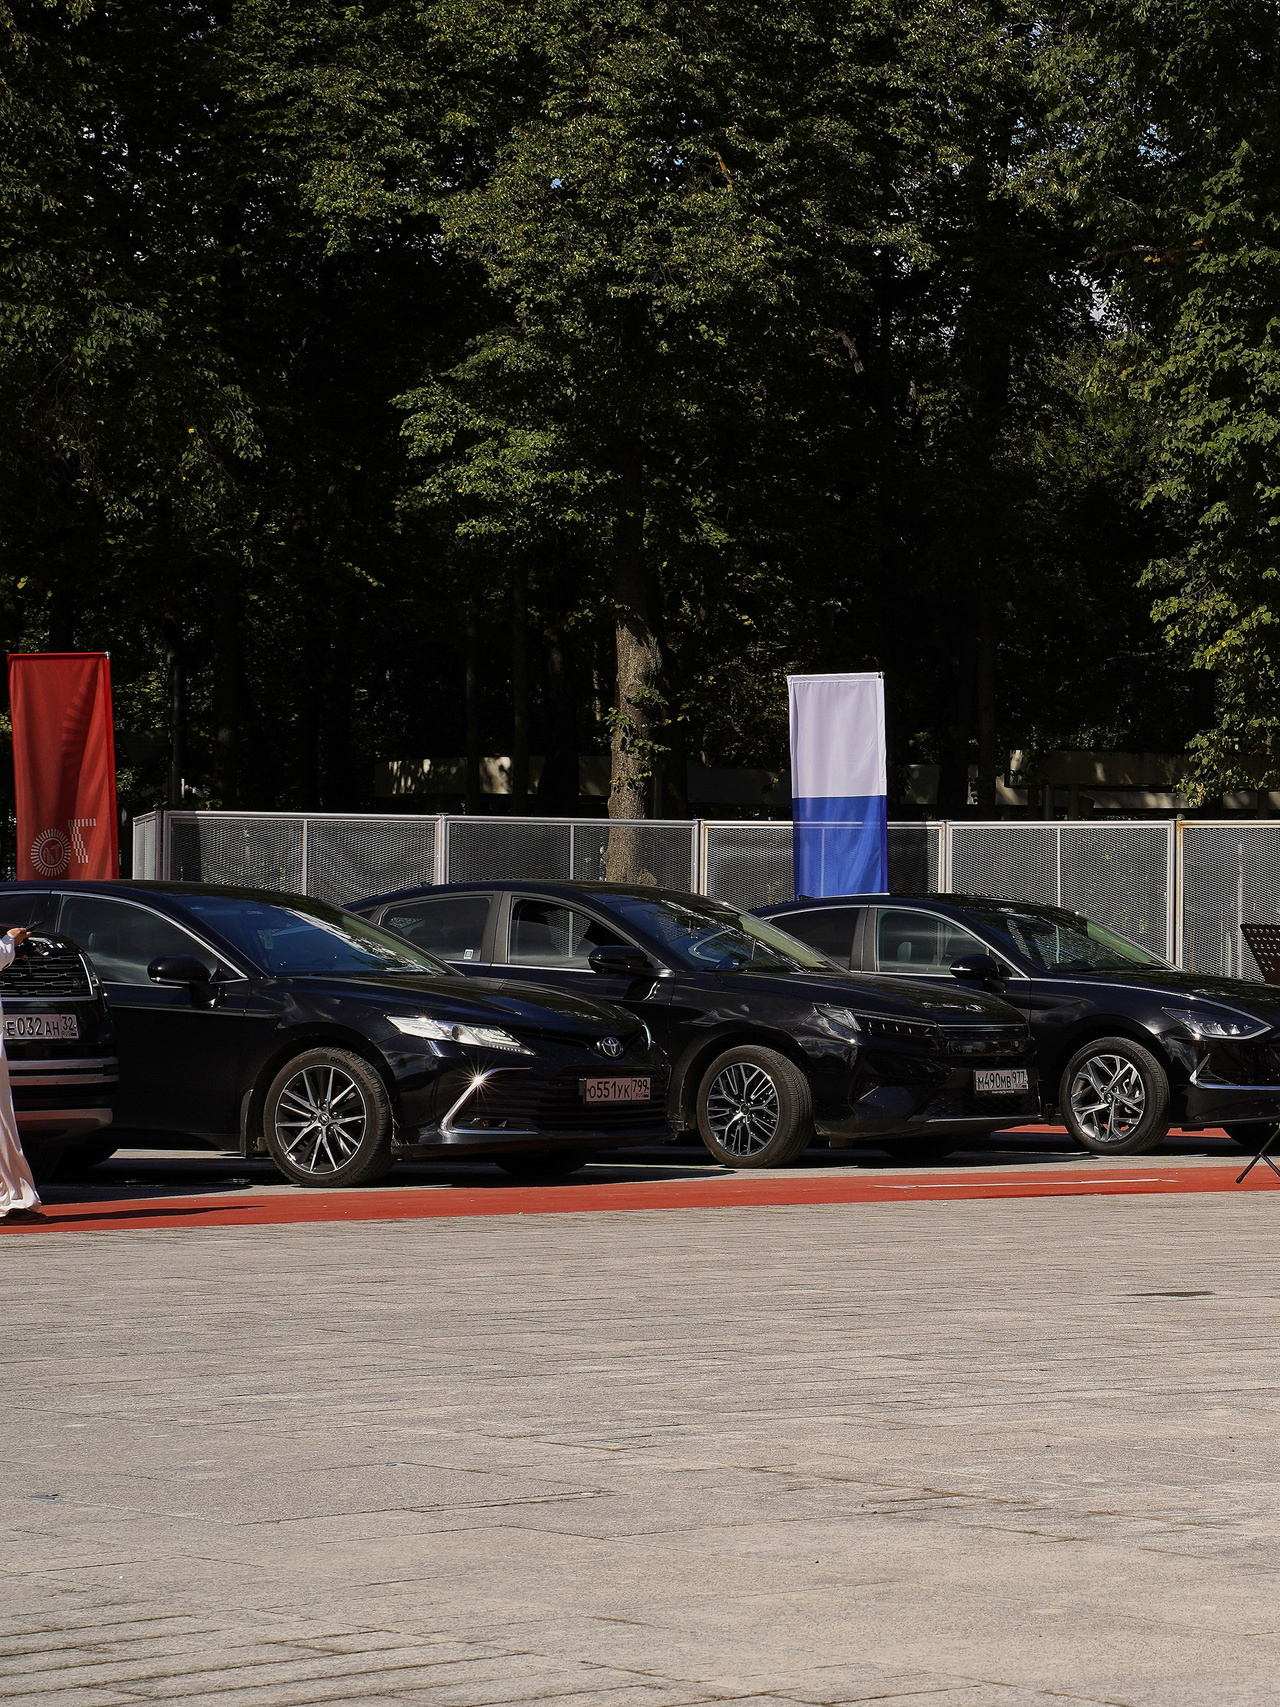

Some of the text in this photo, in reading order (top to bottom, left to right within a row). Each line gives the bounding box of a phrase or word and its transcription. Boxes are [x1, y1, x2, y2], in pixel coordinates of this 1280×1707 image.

[62, 1016, 74, 1031] 32
[1012, 1071, 1024, 1083] 977
[633, 1079, 648, 1092] 799
